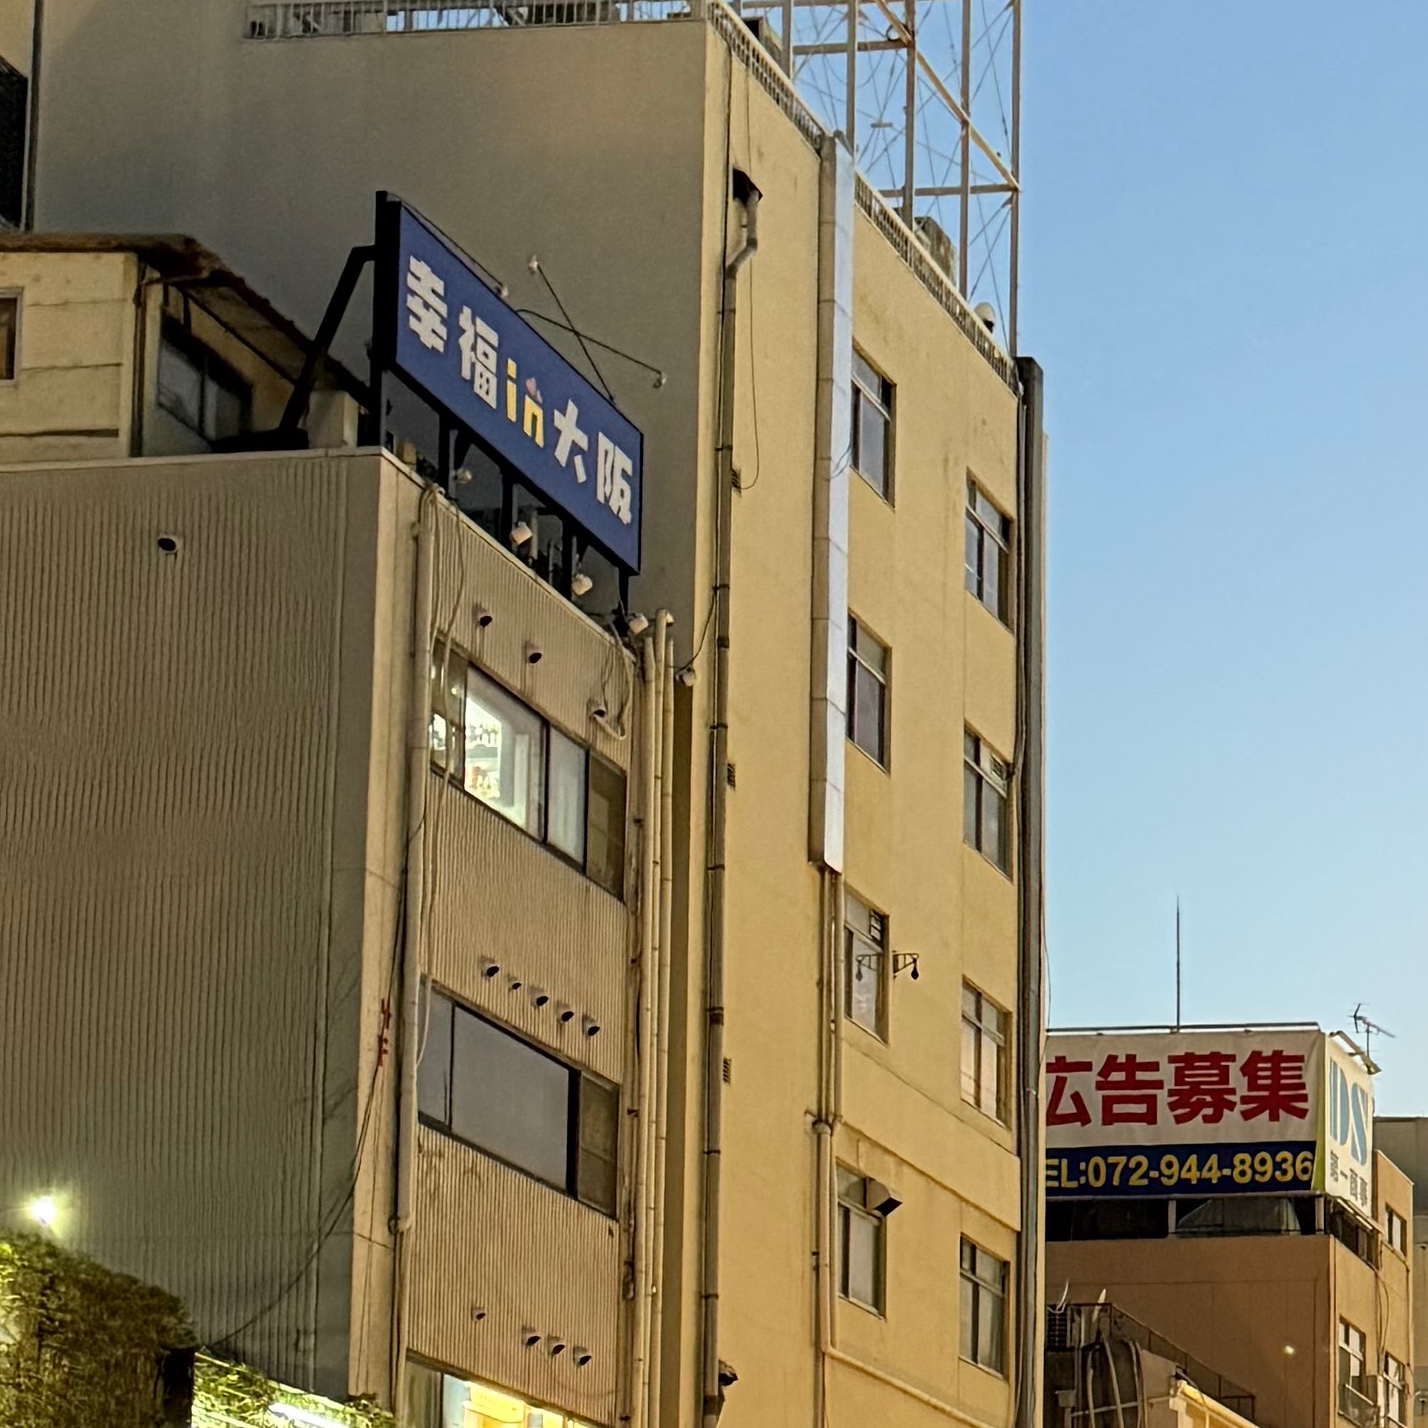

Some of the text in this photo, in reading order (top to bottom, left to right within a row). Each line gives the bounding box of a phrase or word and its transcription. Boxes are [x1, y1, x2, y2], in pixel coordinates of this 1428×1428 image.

[405, 253, 638, 526] 幸福in大阪
[1046, 1049, 1309, 1128] 広告募集
